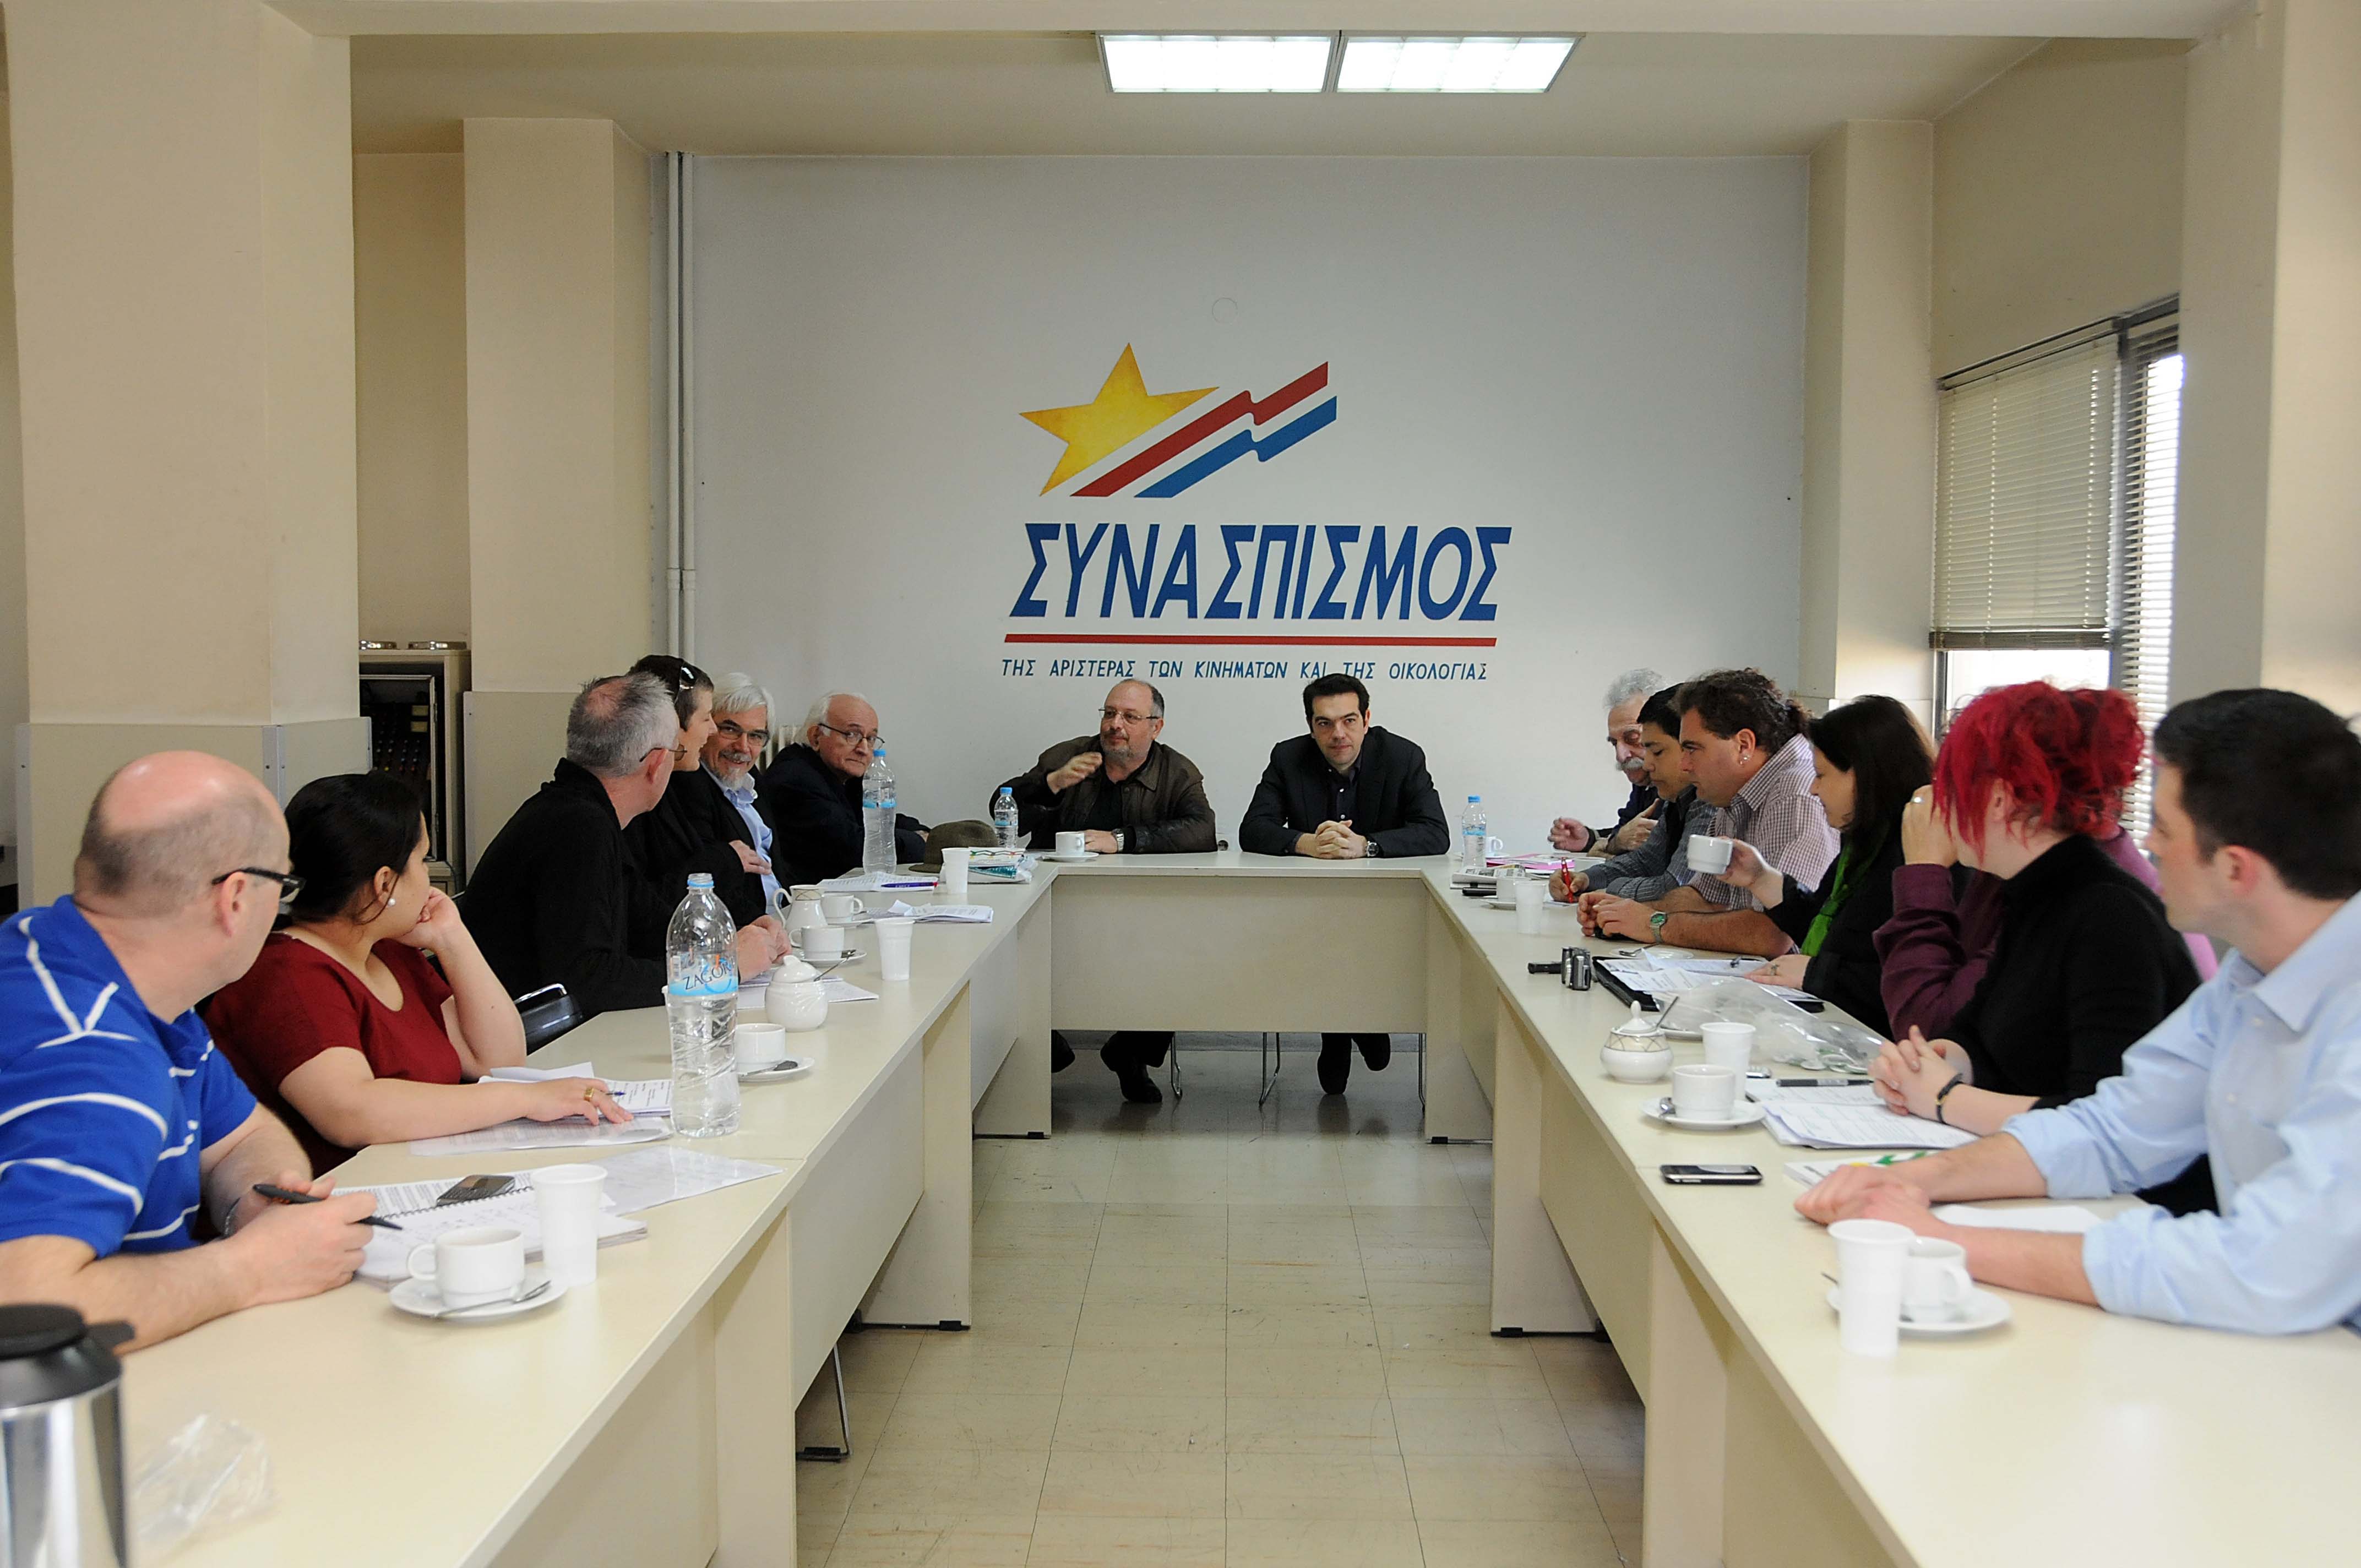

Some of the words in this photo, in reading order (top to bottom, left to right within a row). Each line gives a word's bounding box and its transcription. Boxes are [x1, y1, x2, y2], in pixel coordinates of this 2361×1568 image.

[1009, 522, 1513, 622] ΣΥΝΑΣΠΙΣΜΟΣ
[1002, 659, 1036, 676] ΤΗΣ
[1049, 660, 1135, 678] ΑΡΙΣΤΕΡΑΣ
[1149, 661, 1183, 678] ΤΩΝ
[1194, 661, 1288, 679] ΚΙΝΗΜΑΤΩΝ
[1300, 662, 1326, 679] ΚΑΙ
[1343, 662, 1376, 679] ΤΗΣ
[1389, 663, 1487, 680] ΟΙΚΟΛΟΓΙΑΣ
